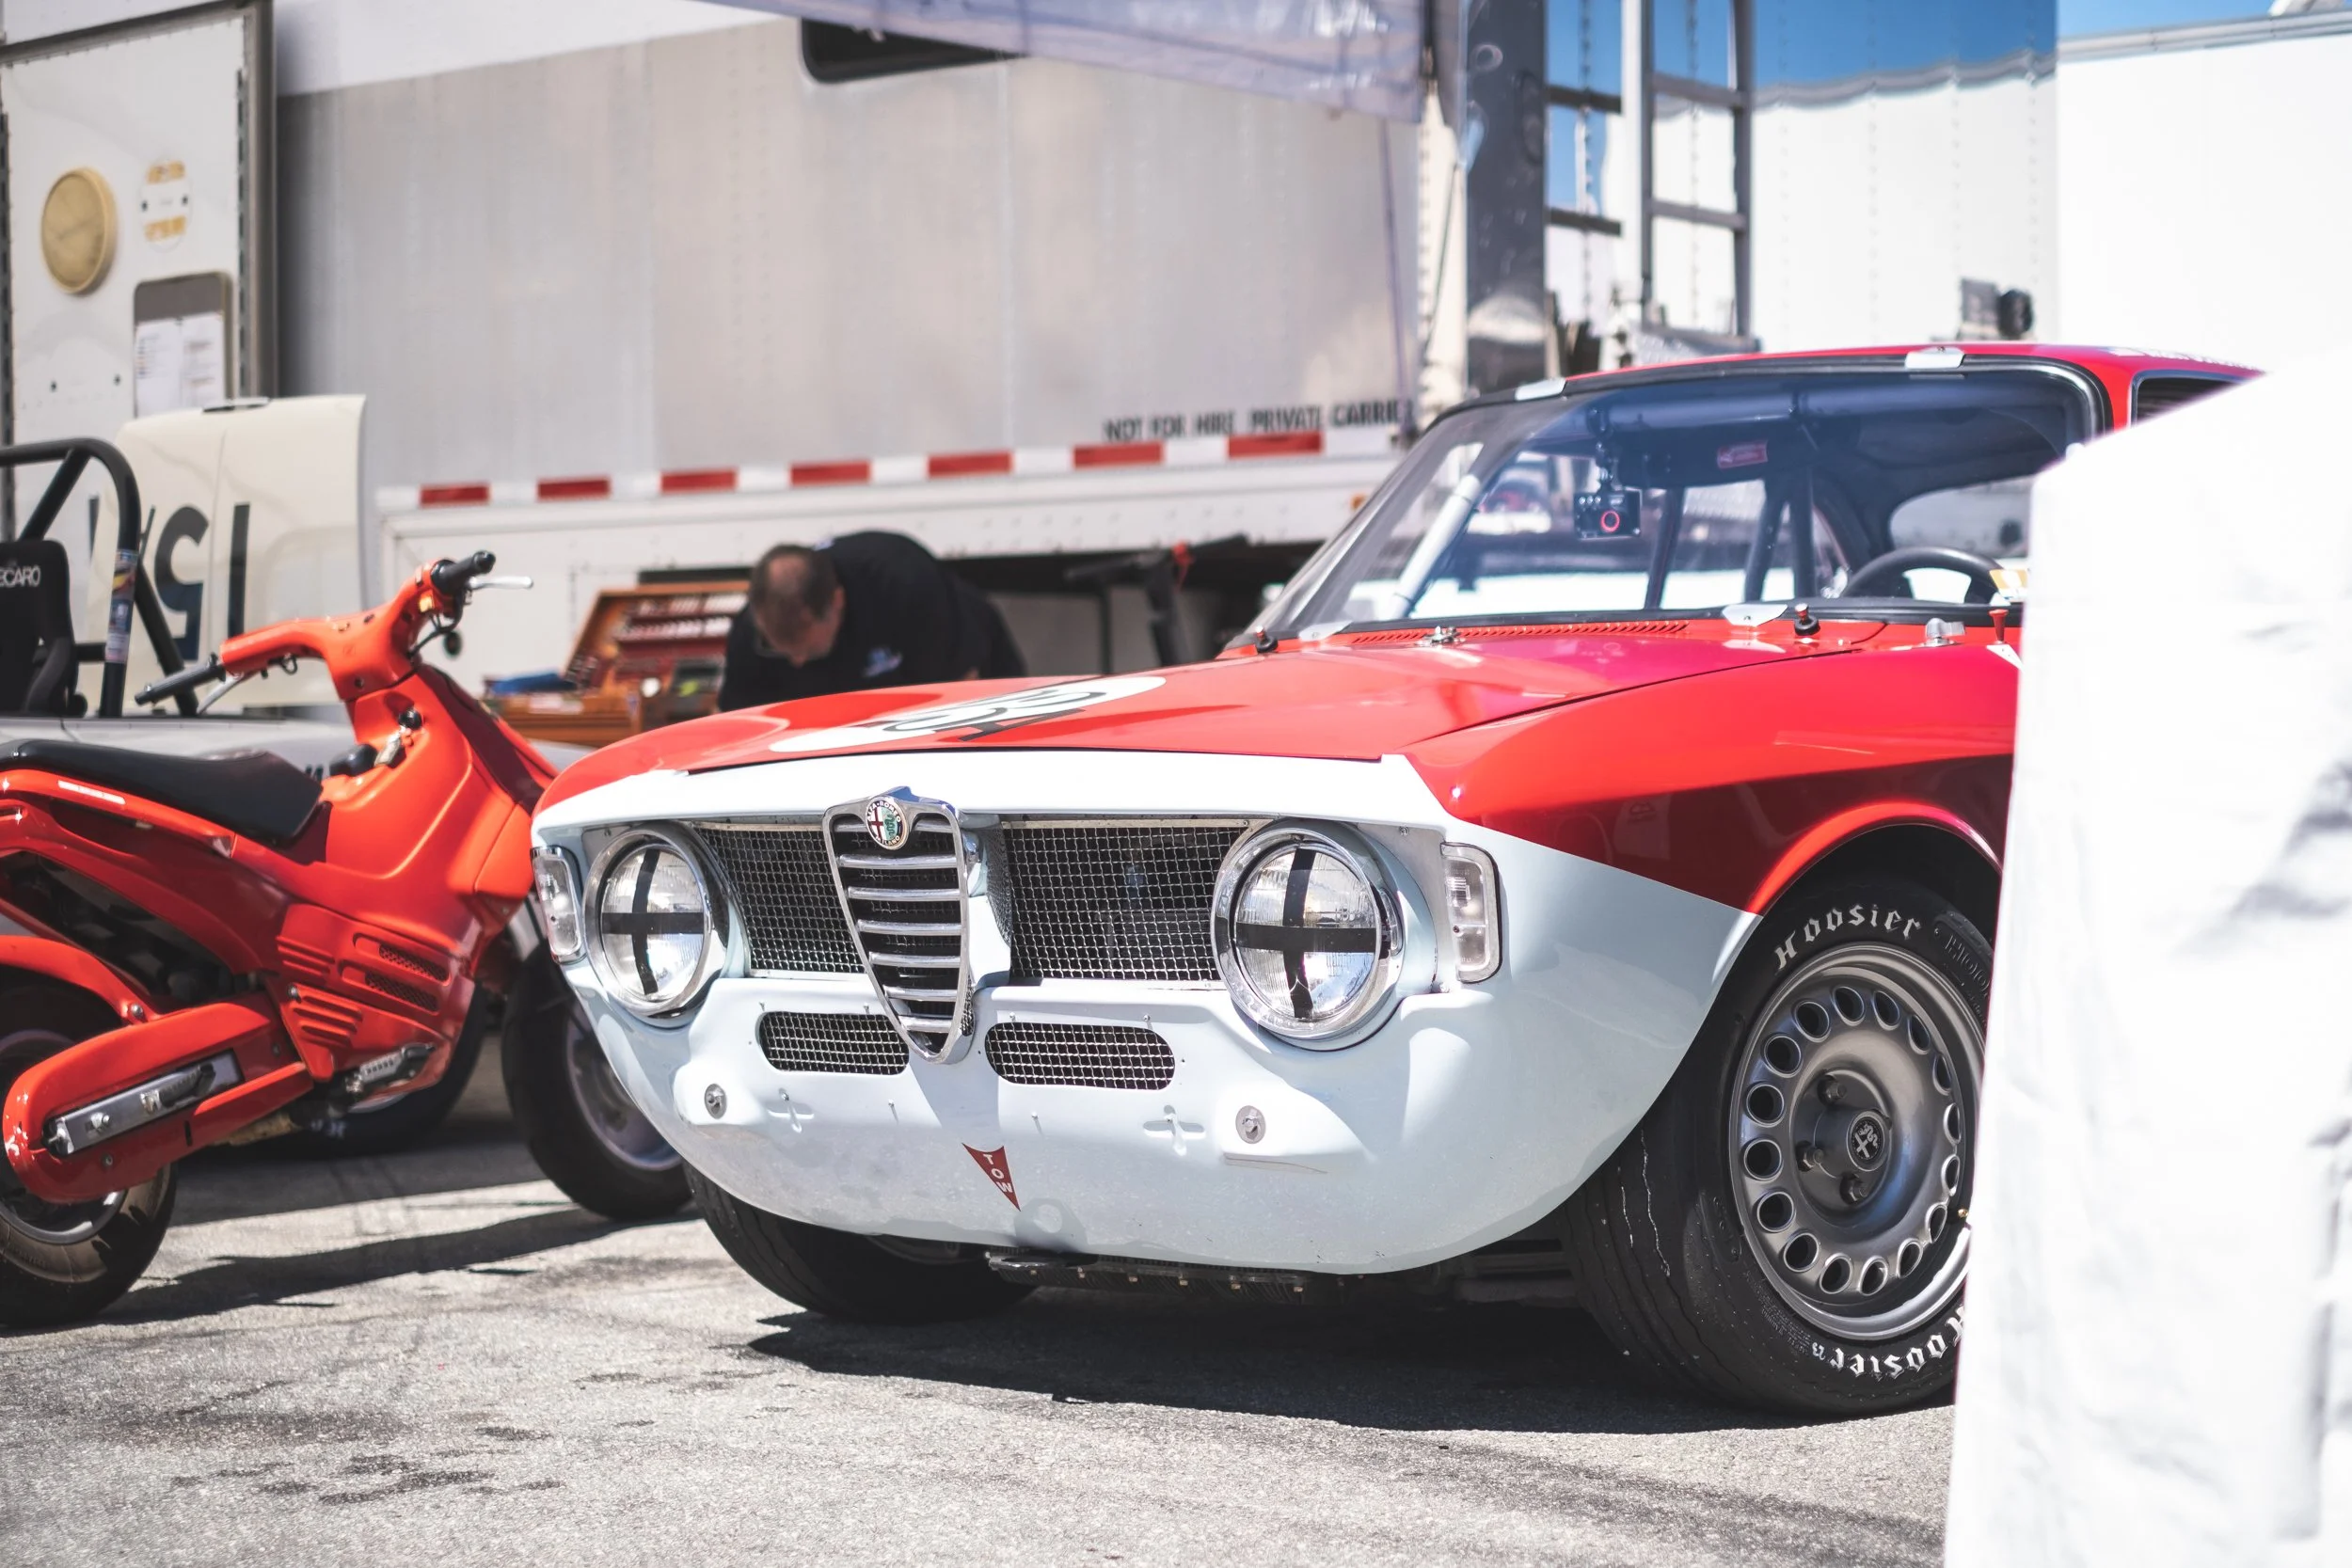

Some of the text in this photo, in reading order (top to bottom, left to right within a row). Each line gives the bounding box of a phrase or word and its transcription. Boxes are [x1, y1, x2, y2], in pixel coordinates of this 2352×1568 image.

[1249, 404, 1322, 433] PRIVATE
[1773, 904, 1922, 973] Hoosier
[982, 1153, 1014, 1193] TOW
